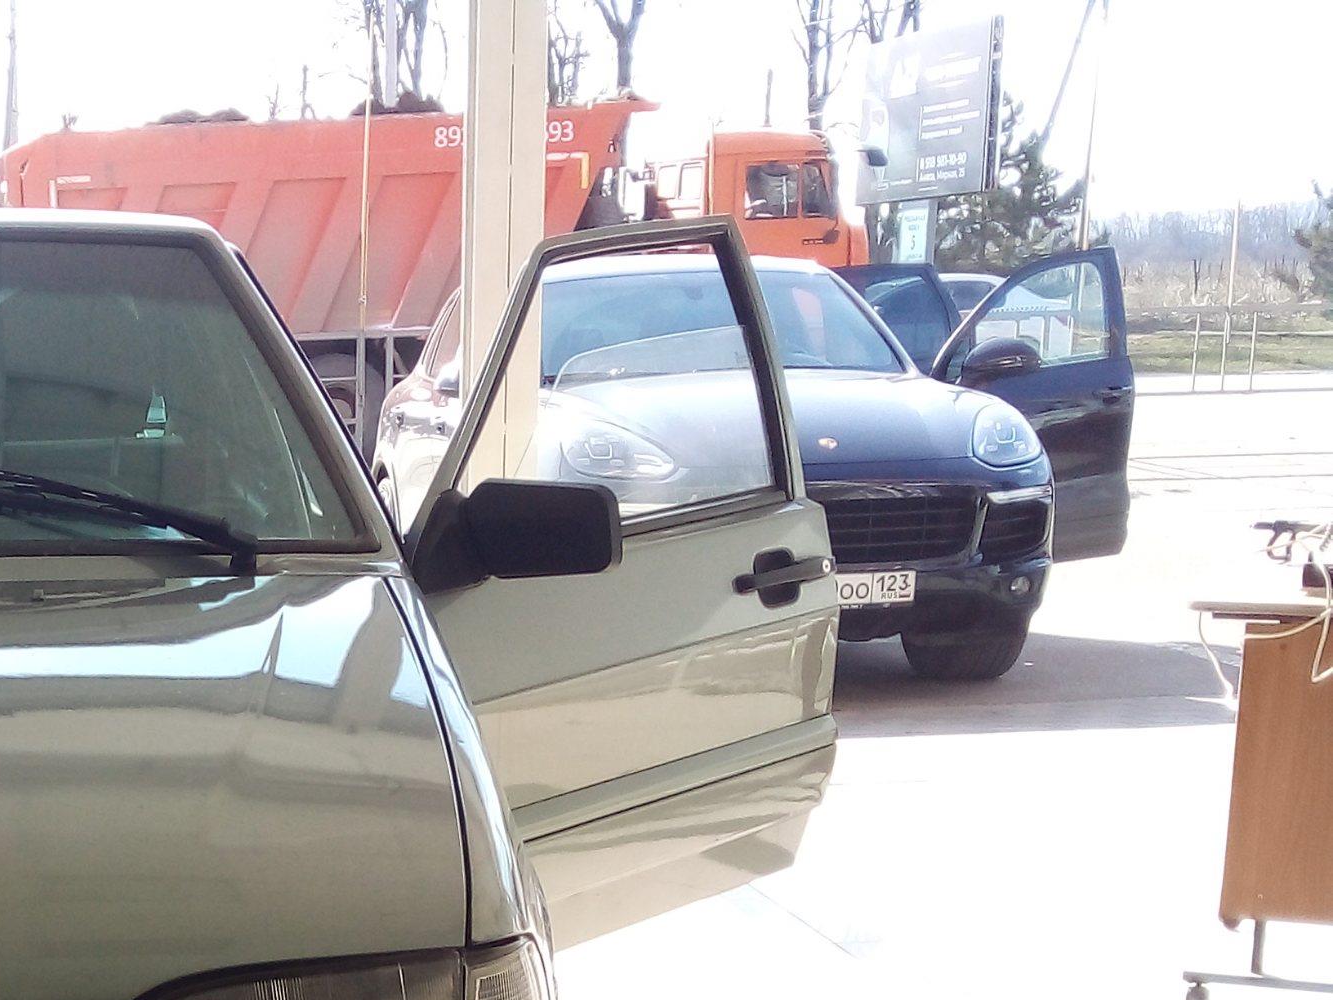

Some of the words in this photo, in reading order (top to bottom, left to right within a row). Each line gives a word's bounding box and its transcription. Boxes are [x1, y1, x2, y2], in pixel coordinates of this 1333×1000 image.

[835, 580, 870, 599] ОО
[876, 574, 910, 592] 123
[881, 592, 898, 600] RUS
